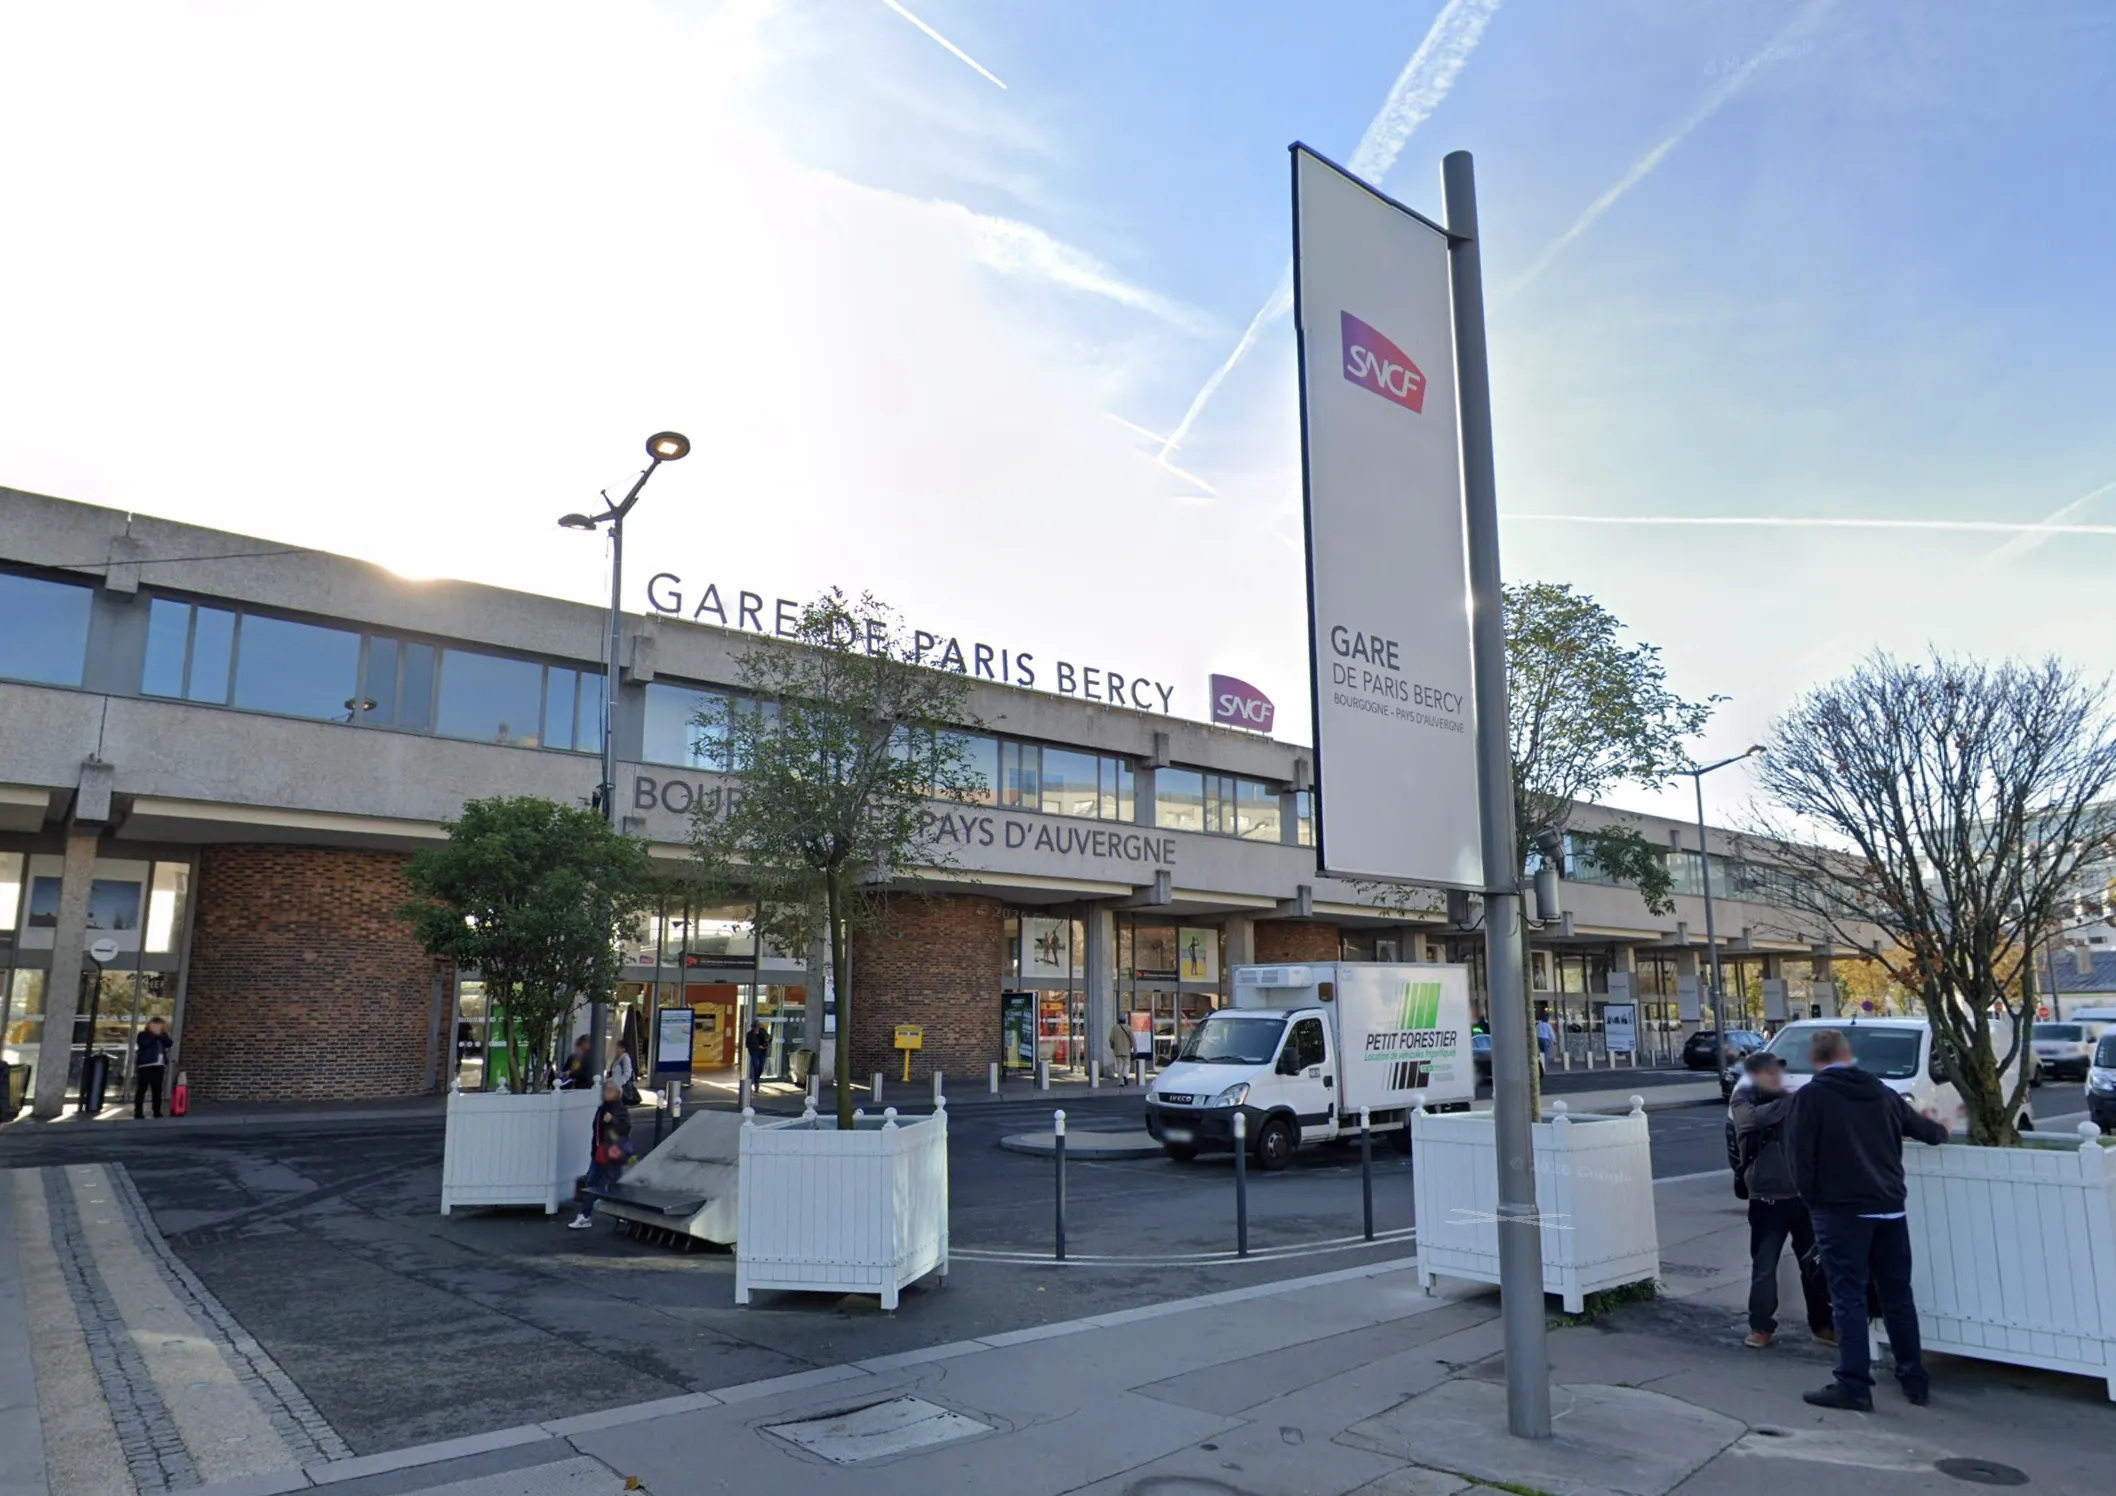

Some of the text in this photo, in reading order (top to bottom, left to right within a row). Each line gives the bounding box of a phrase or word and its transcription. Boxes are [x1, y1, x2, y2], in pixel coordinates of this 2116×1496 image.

[1347, 345, 1420, 398] SNCF
[647, 572, 1174, 714] GARE DE PARIS BERCY
[1331, 624, 1400, 671] GARE
[1216, 694, 1272, 723] SNCF
[1333, 662, 1463, 714] DE PARIS BERCY
[1334, 692, 1389, 717] BOURGOGNE
[1396, 708, 1415, 723] PAYS
[1416, 712, 1465, 734] D'AUVERGNE
[917, 809, 995, 847] PAYS
[1005, 820, 1177, 865] D'AUVERGNE
[1365, 1030, 1457, 1051] PETIT FORESTIER
[1169, 1094, 1192, 1103] IVECO
